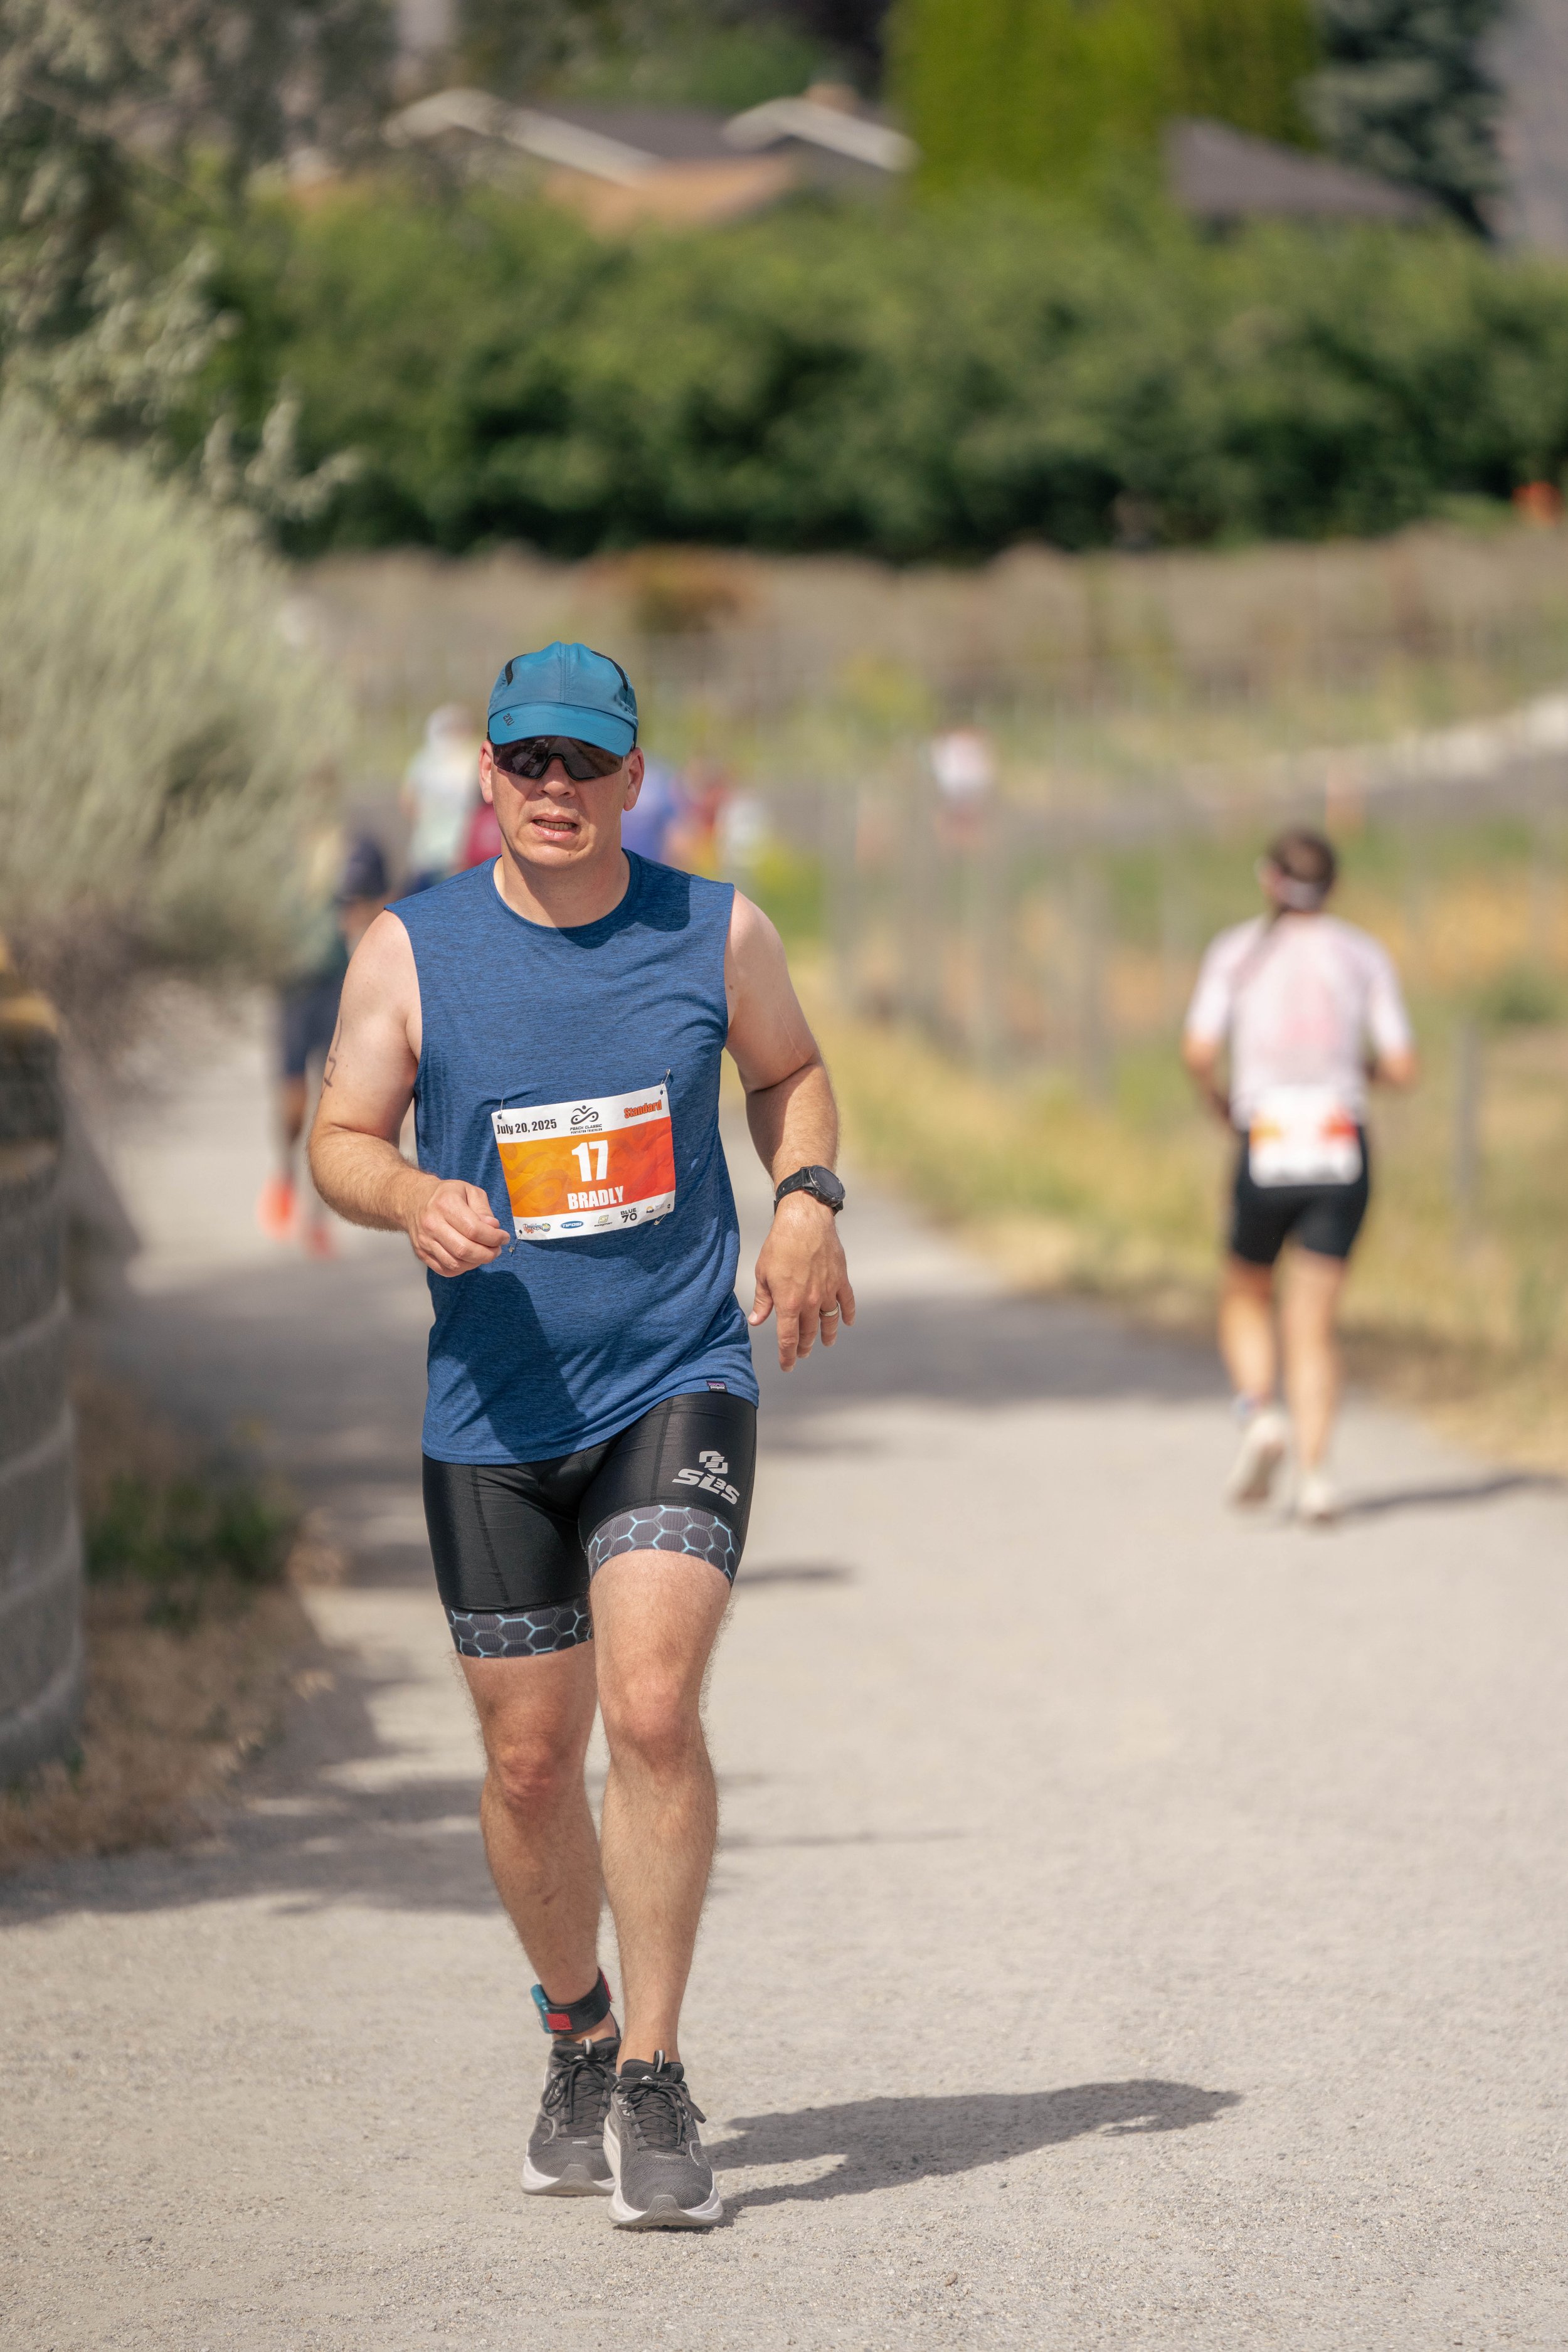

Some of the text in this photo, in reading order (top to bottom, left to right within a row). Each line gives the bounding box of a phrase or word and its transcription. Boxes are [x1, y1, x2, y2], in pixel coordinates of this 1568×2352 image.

[503, 712, 515, 726] 2XU
[623, 1099, 662, 1119] Standard
[497, 1119, 557, 1135] July 20, 2025
[571, 1140, 608, 1182] 17
[567, 1185, 623, 1210] BRADLY
[620, 1207, 637, 1216] BLUE
[622, 1212, 637, 1223] 70
